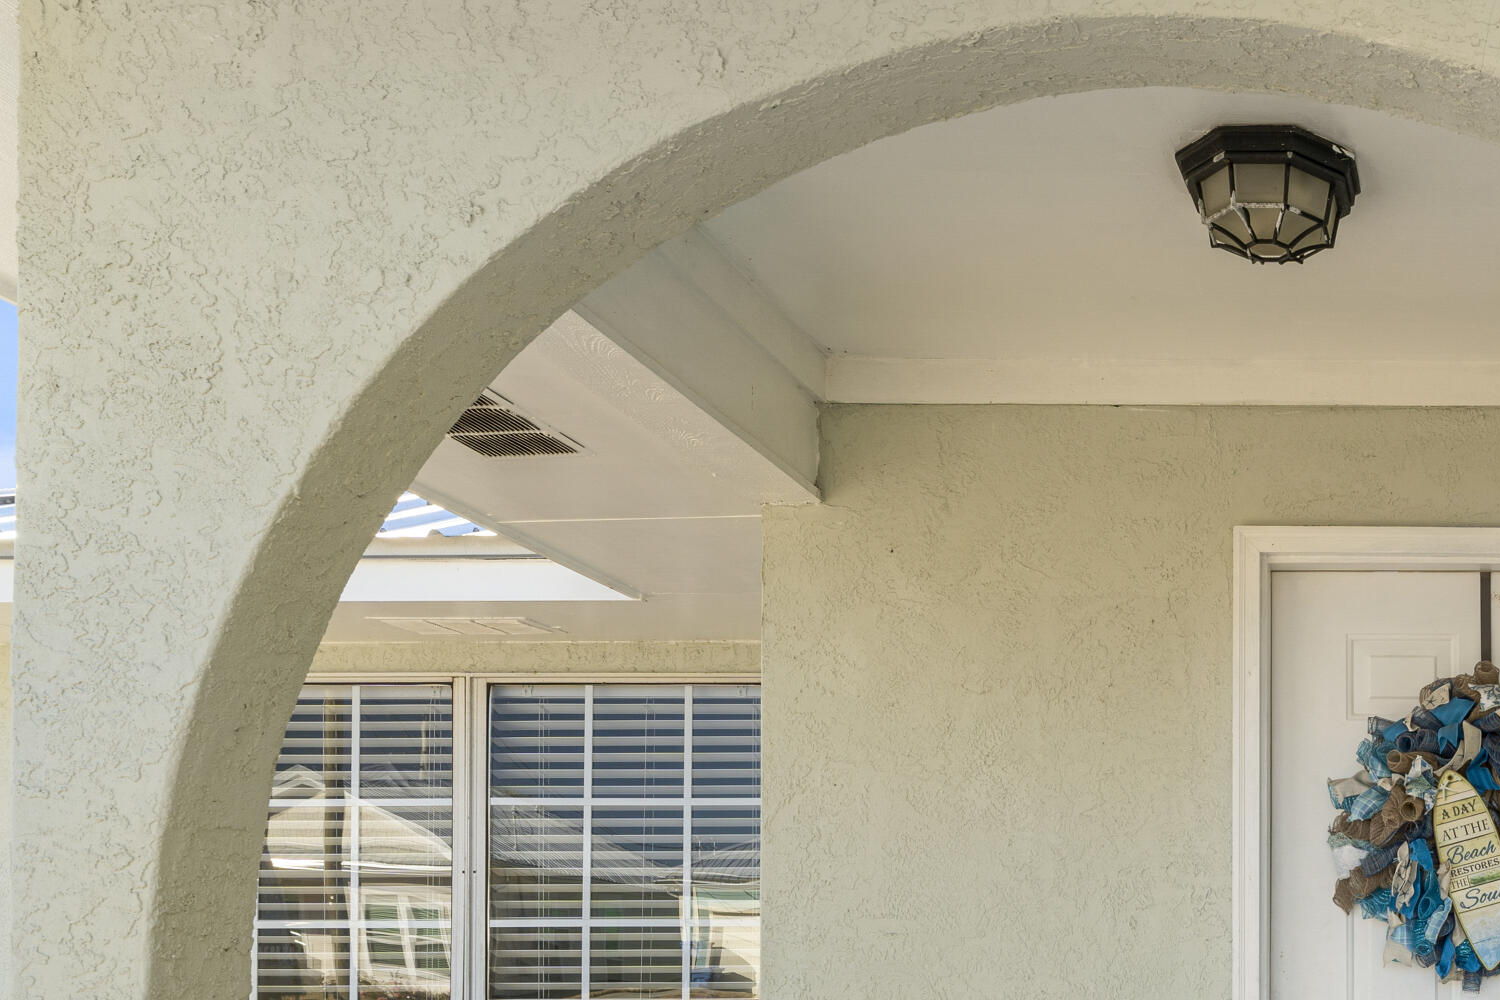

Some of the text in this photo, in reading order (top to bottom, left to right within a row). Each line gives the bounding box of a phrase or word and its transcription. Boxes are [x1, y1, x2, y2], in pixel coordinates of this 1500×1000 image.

[1442, 799, 1476, 820] A DAY
[1443, 818, 1490, 841] AT THE
[1447, 840, 1496, 864] Beach
[1450, 857, 1500, 878] RESTORES
[1450, 878, 1468, 889] THE
